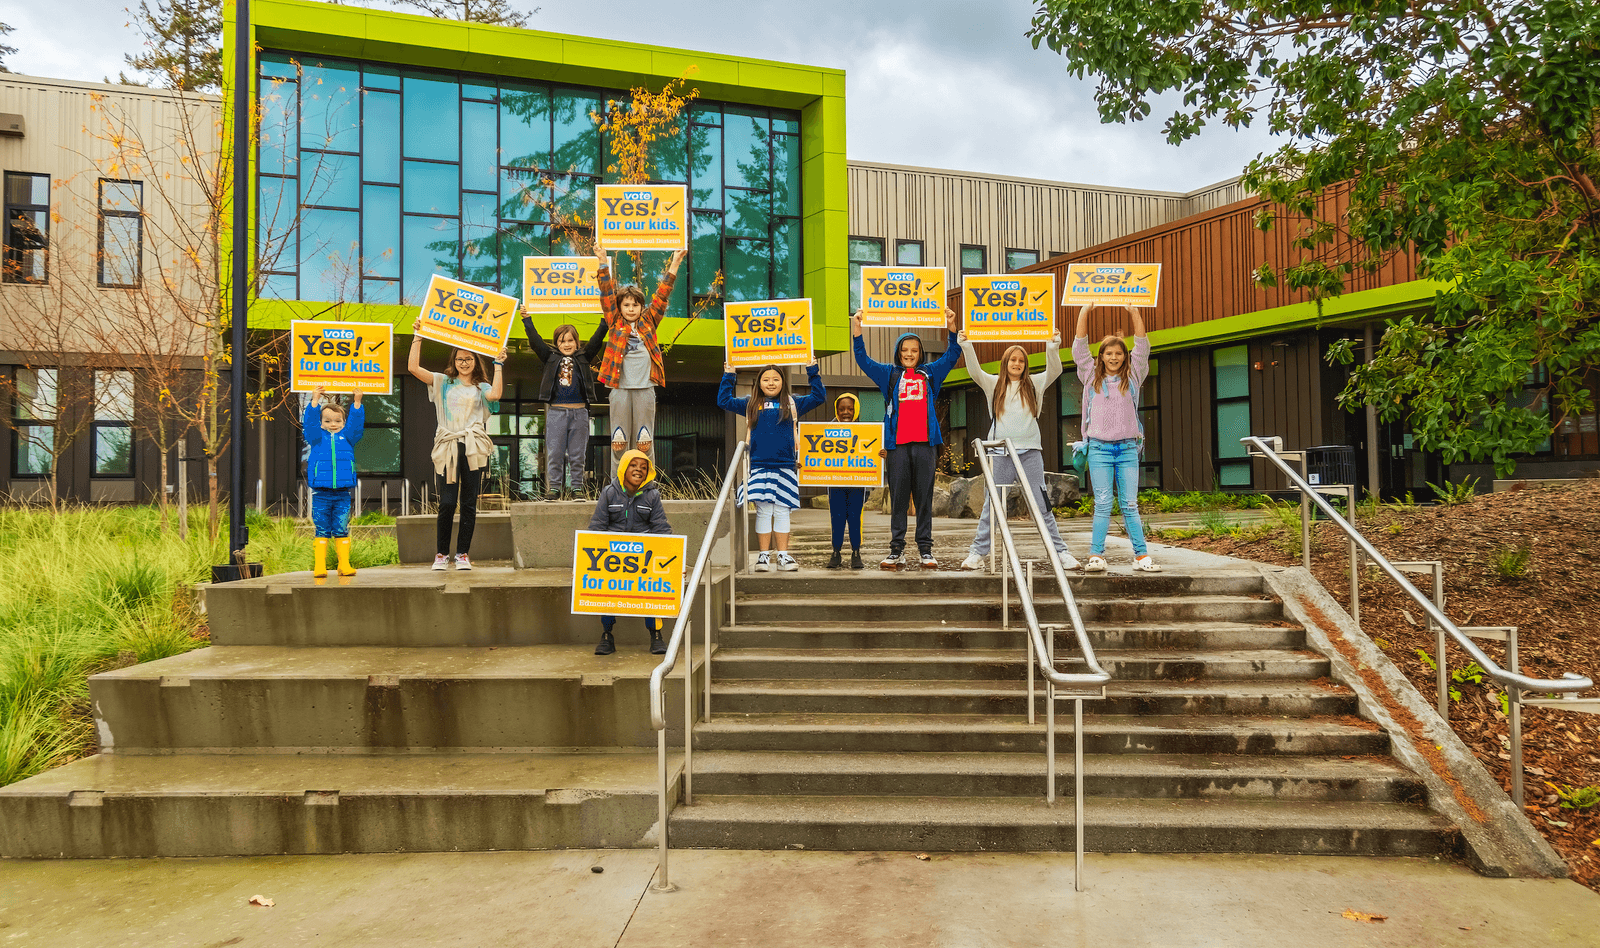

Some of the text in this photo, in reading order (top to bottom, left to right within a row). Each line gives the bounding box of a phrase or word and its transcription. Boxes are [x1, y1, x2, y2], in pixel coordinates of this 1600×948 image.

[625, 192, 651, 200] vote
[602, 198, 659, 216] Yes!
[604, 218, 679, 230] for our kids.
[529, 268, 585, 283] Yes!
[1073, 272, 1132, 284] Yes!
[531, 286, 547, 295] for
[575, 286, 601, 295] kids
[867, 278, 921, 296] Yes!
[1072, 285, 1090, 293] for
[1119, 285, 1150, 293] kids.
[435, 288, 490, 319] Yes!
[458, 290, 483, 303] vote
[868, 297, 940, 309] for our kids.
[969, 287, 1027, 307] Yes!
[752, 308, 777, 316] vote
[971, 309, 1047, 321] for our kids.
[428, 308, 500, 339] for our kids.
[730, 312, 785, 333] Yes!
[324, 330, 353, 338] vote
[733, 333, 806, 347] for our kids.
[299, 335, 363, 357] Yes!
[300, 358, 384, 372] for our kids.
[804, 435, 858, 453] Yes!
[805, 455, 877, 467] for our kids.
[611, 542, 642, 552] vote
[582, 548, 653, 574] Yes!
[582, 574, 675, 593] for our kids.
